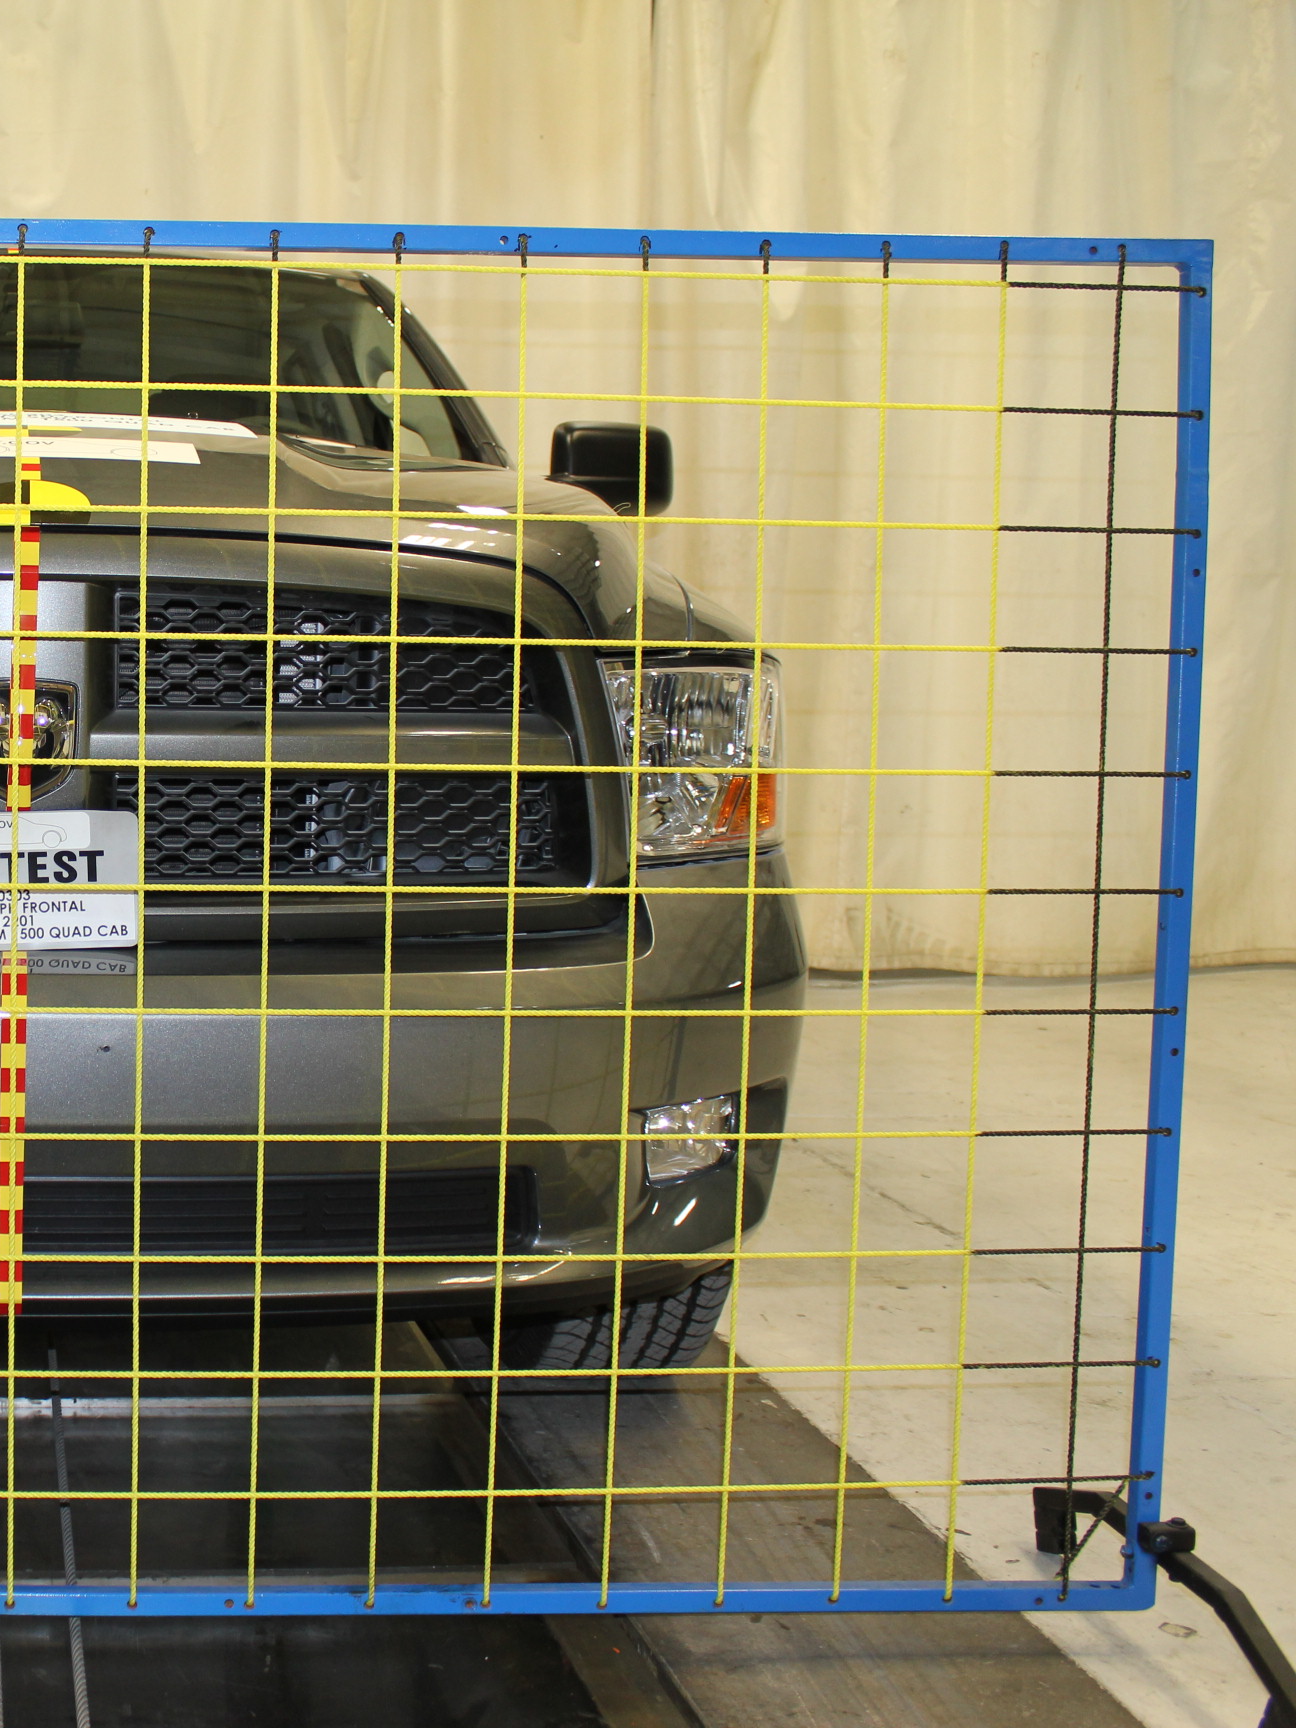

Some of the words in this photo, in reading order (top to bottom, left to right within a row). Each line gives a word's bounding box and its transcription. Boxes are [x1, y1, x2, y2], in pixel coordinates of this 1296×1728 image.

[23, 900, 86, 914] FRONTAL
[49, 925, 92, 939] QUAD
[97, 924, 128, 937] CAB
